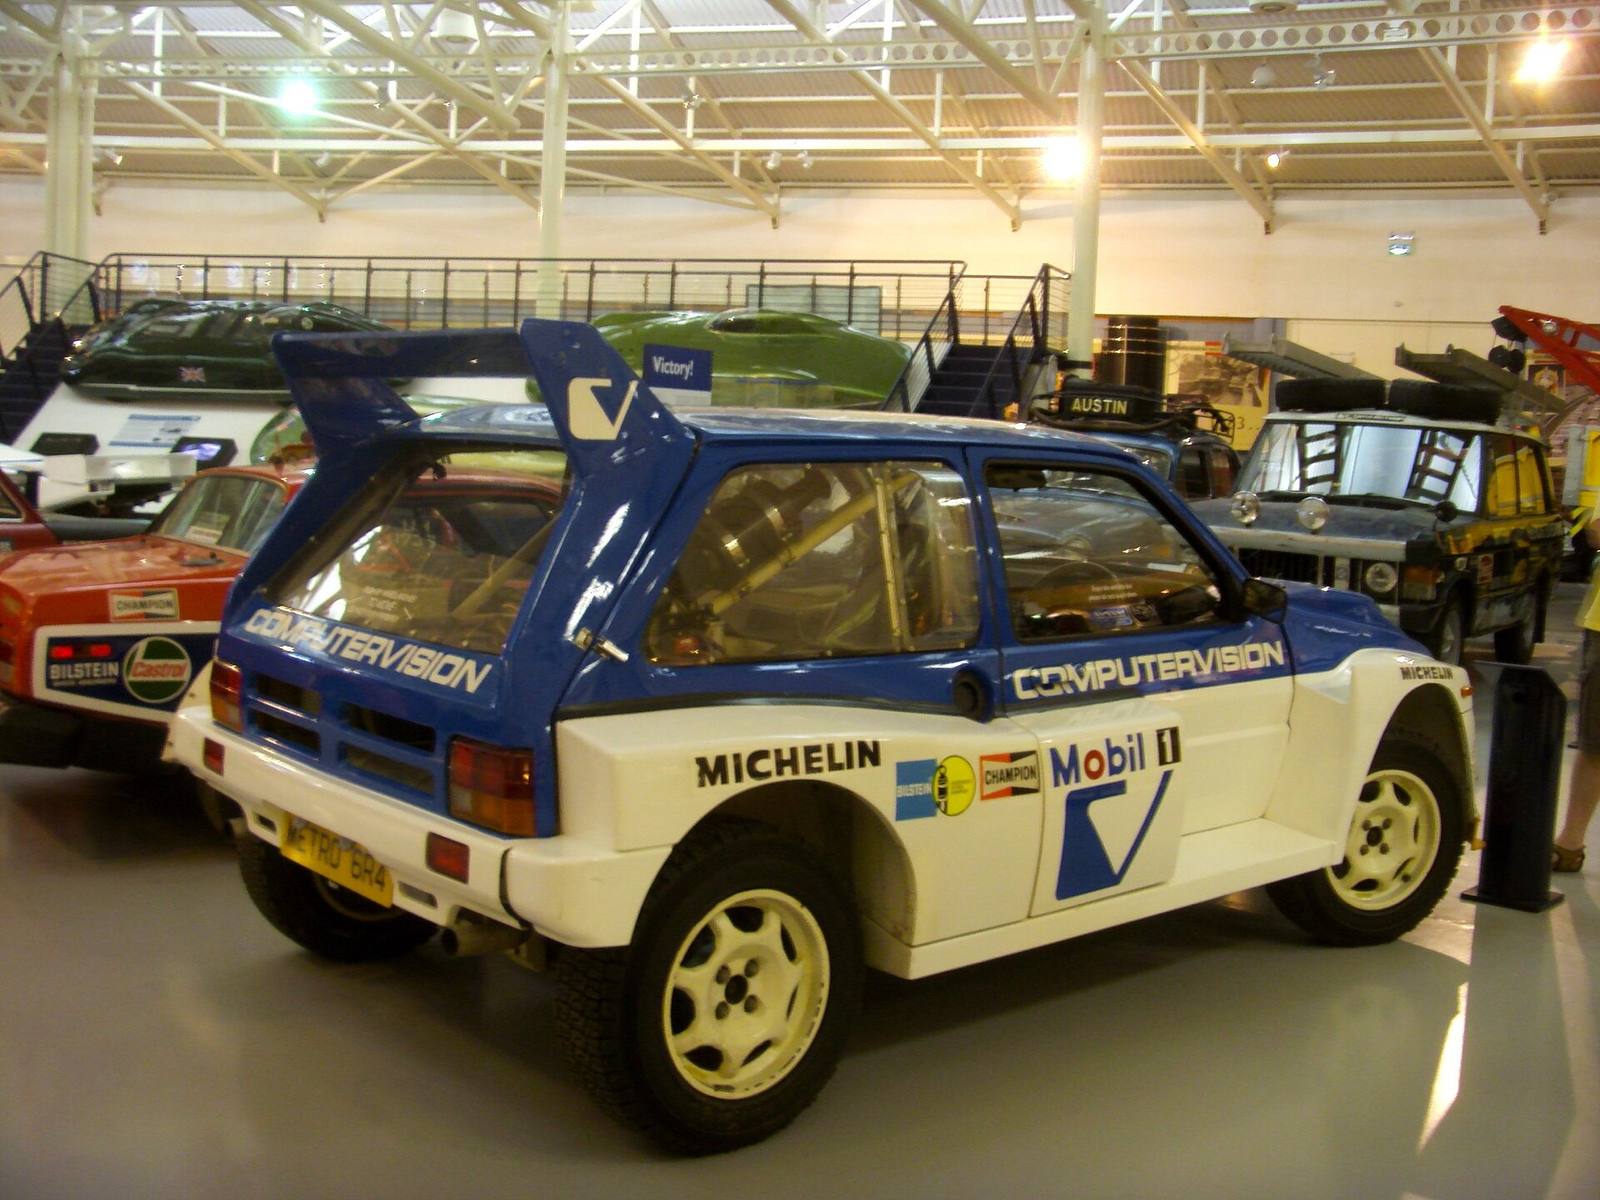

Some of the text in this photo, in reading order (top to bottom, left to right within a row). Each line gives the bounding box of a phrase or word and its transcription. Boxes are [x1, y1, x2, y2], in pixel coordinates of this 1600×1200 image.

[652, 355, 694, 381] Victory!
[1071, 397, 1128, 415] AUSTIN
[116, 599, 174, 611] CHAMPION
[244, 608, 493, 694] COMPUTERVISION
[50, 662, 119, 680] BILSTEIN
[132, 662, 187, 678] Castrol
[1013, 640, 1285, 701] COMPUTERVISION
[1399, 666, 1454, 681] MICHELIN
[695, 740, 882, 788] MICHELIN
[1050, 727, 1178, 788] Mobil 1
[985, 765, 1038, 785] CHAMPION
[896, 783, 932, 798] BILSTEIN
[351, 846, 386, 892] 6R4
